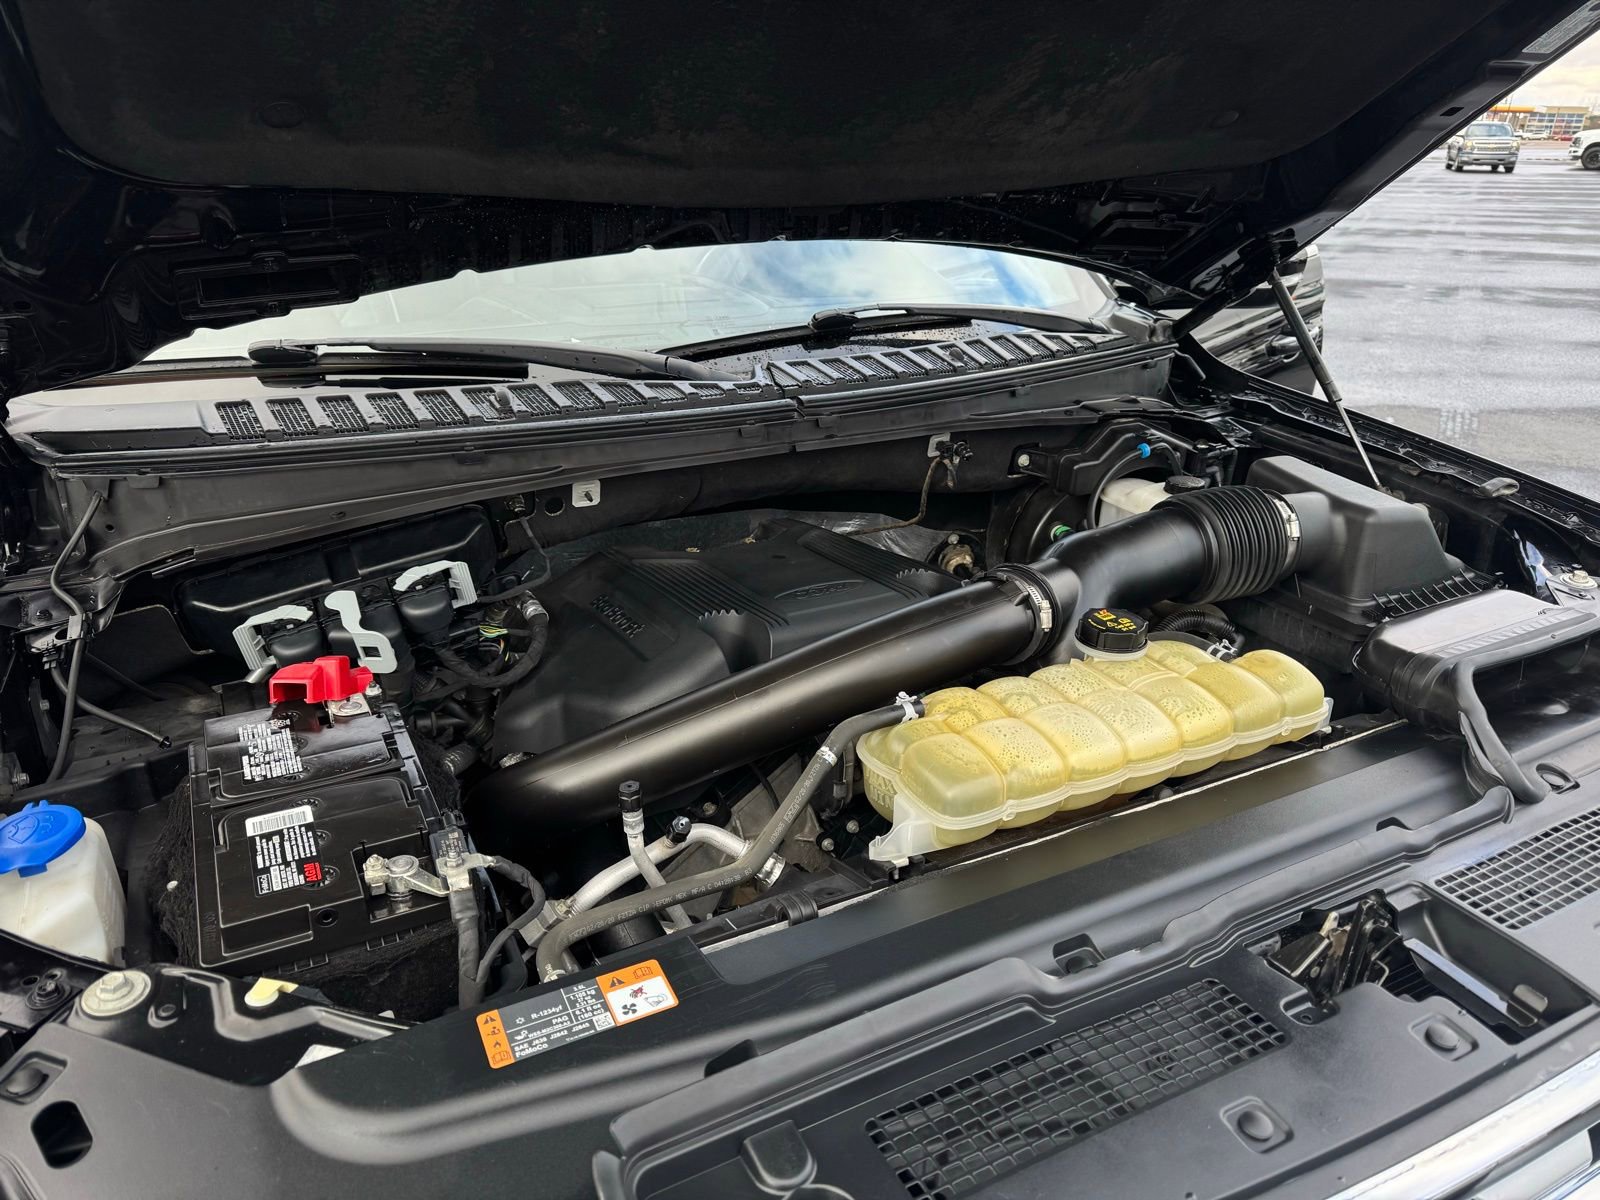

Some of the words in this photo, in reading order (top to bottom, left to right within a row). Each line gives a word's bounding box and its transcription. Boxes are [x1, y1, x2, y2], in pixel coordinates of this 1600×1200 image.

[304, 862, 318, 882] AGM
[531, 1005, 562, 1019] R-1234yf
[552, 1016, 568, 1024] PAG
[514, 1043, 529, 1051] SAE
[515, 1043, 548, 1058] FoMoCo
